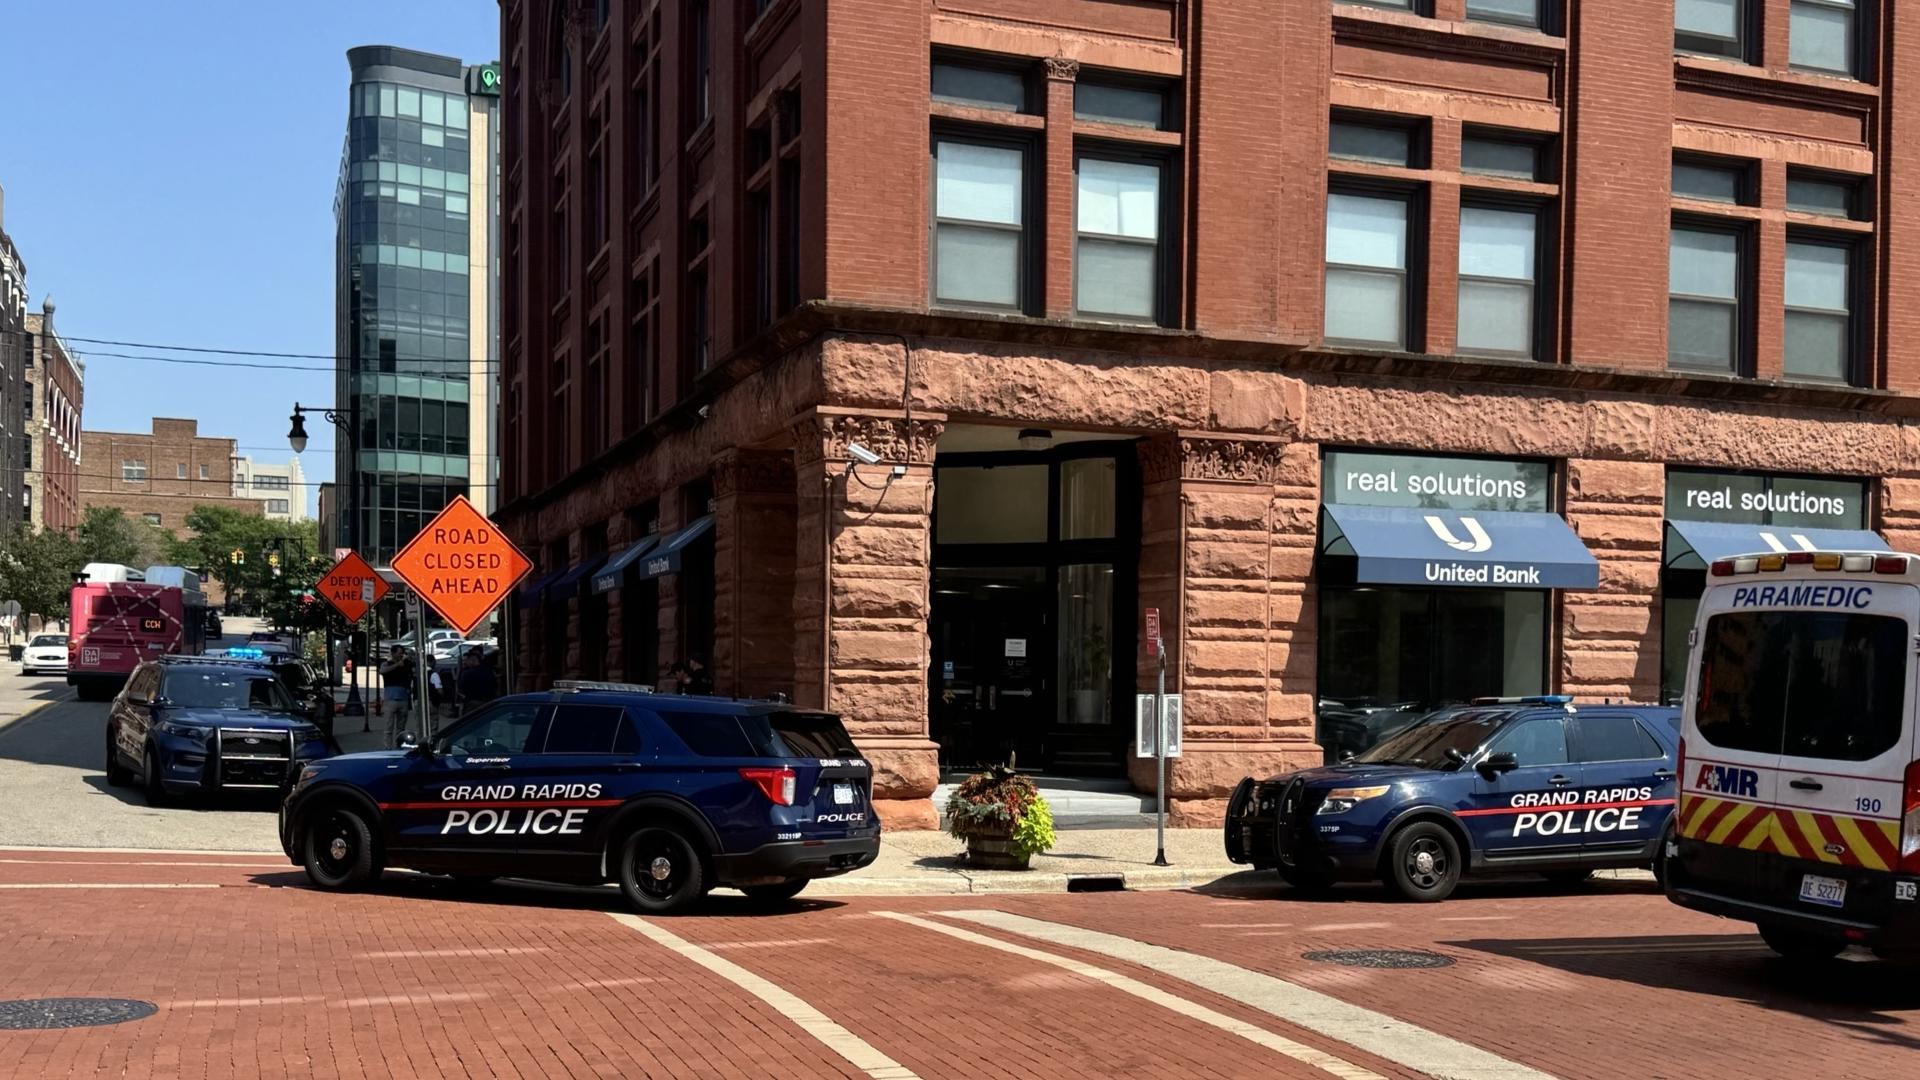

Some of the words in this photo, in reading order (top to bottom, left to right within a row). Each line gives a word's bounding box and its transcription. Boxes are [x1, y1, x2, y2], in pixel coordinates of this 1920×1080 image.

[1347, 469, 1398, 493] real
[1408, 471, 1526, 499] solutions
[1687, 487, 1733, 510] real
[1741, 489, 1845, 515] solutions
[435, 528, 489, 544] ROAD
[424, 553, 501, 569] CLOSED
[1425, 563, 1488, 583] United
[1493, 566, 1540, 584] Bank
[333, 591, 366, 601] AHE
[431, 578, 498, 594] AHEAD
[1732, 586, 1873, 609] PARAMEDIC
[441, 785, 516, 800] GRAND
[522, 783, 602, 799] RAPIDS
[1695, 764, 1758, 798] AMR
[1511, 791, 1579, 808] GRAND
[1584, 787, 1652, 804] RAPIDS
[1855, 797, 1881, 813] 190
[441, 808, 589, 835] POLICE
[817, 813, 864, 822] POLICE
[1512, 807, 1643, 837] POLICE
